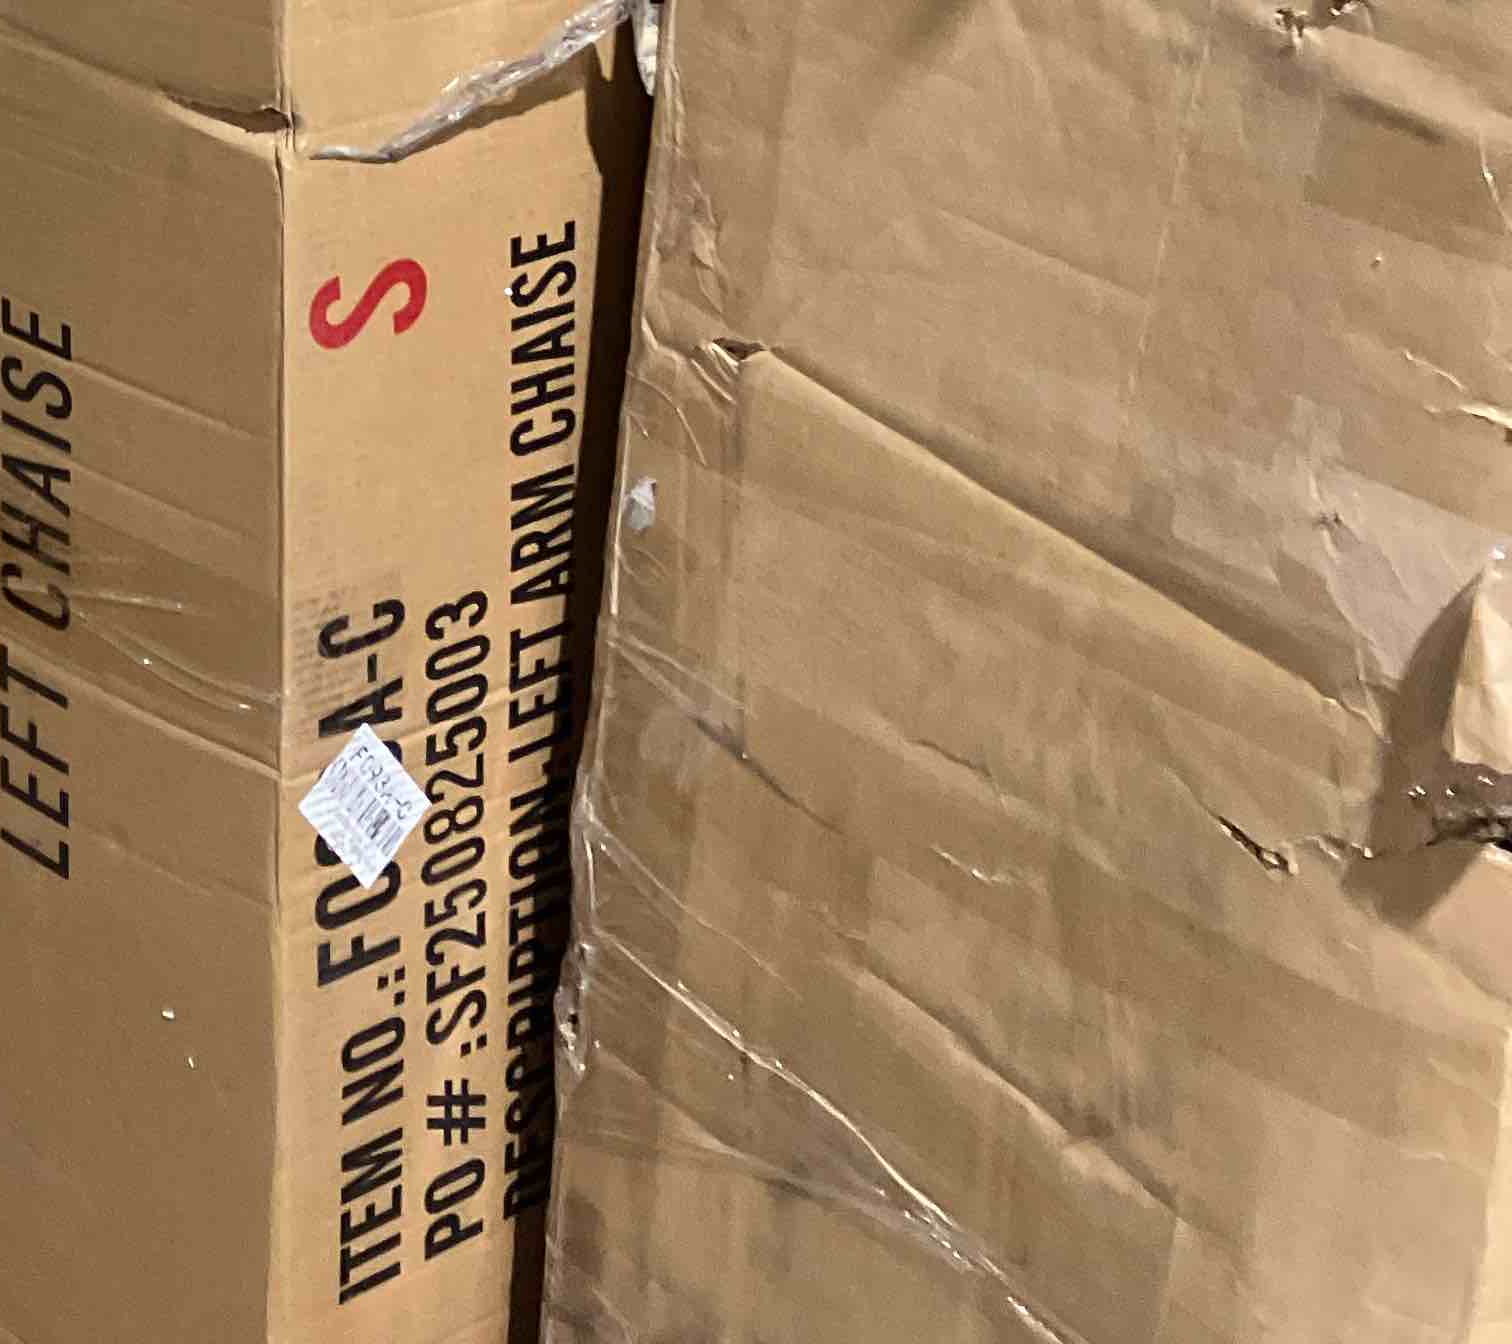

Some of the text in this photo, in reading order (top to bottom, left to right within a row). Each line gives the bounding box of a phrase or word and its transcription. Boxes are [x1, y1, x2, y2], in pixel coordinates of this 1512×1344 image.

[308, 256, 429, 352] S
[508, 219, 578, 456] CHAISE
[0, 295, 74, 632] CHAISE
[510, 463, 579, 612] ARM
[423, 1075, 488, 1148] #
[337, 1126, 405, 1306] ITEM
[423, 1151, 485, 1265] PO
